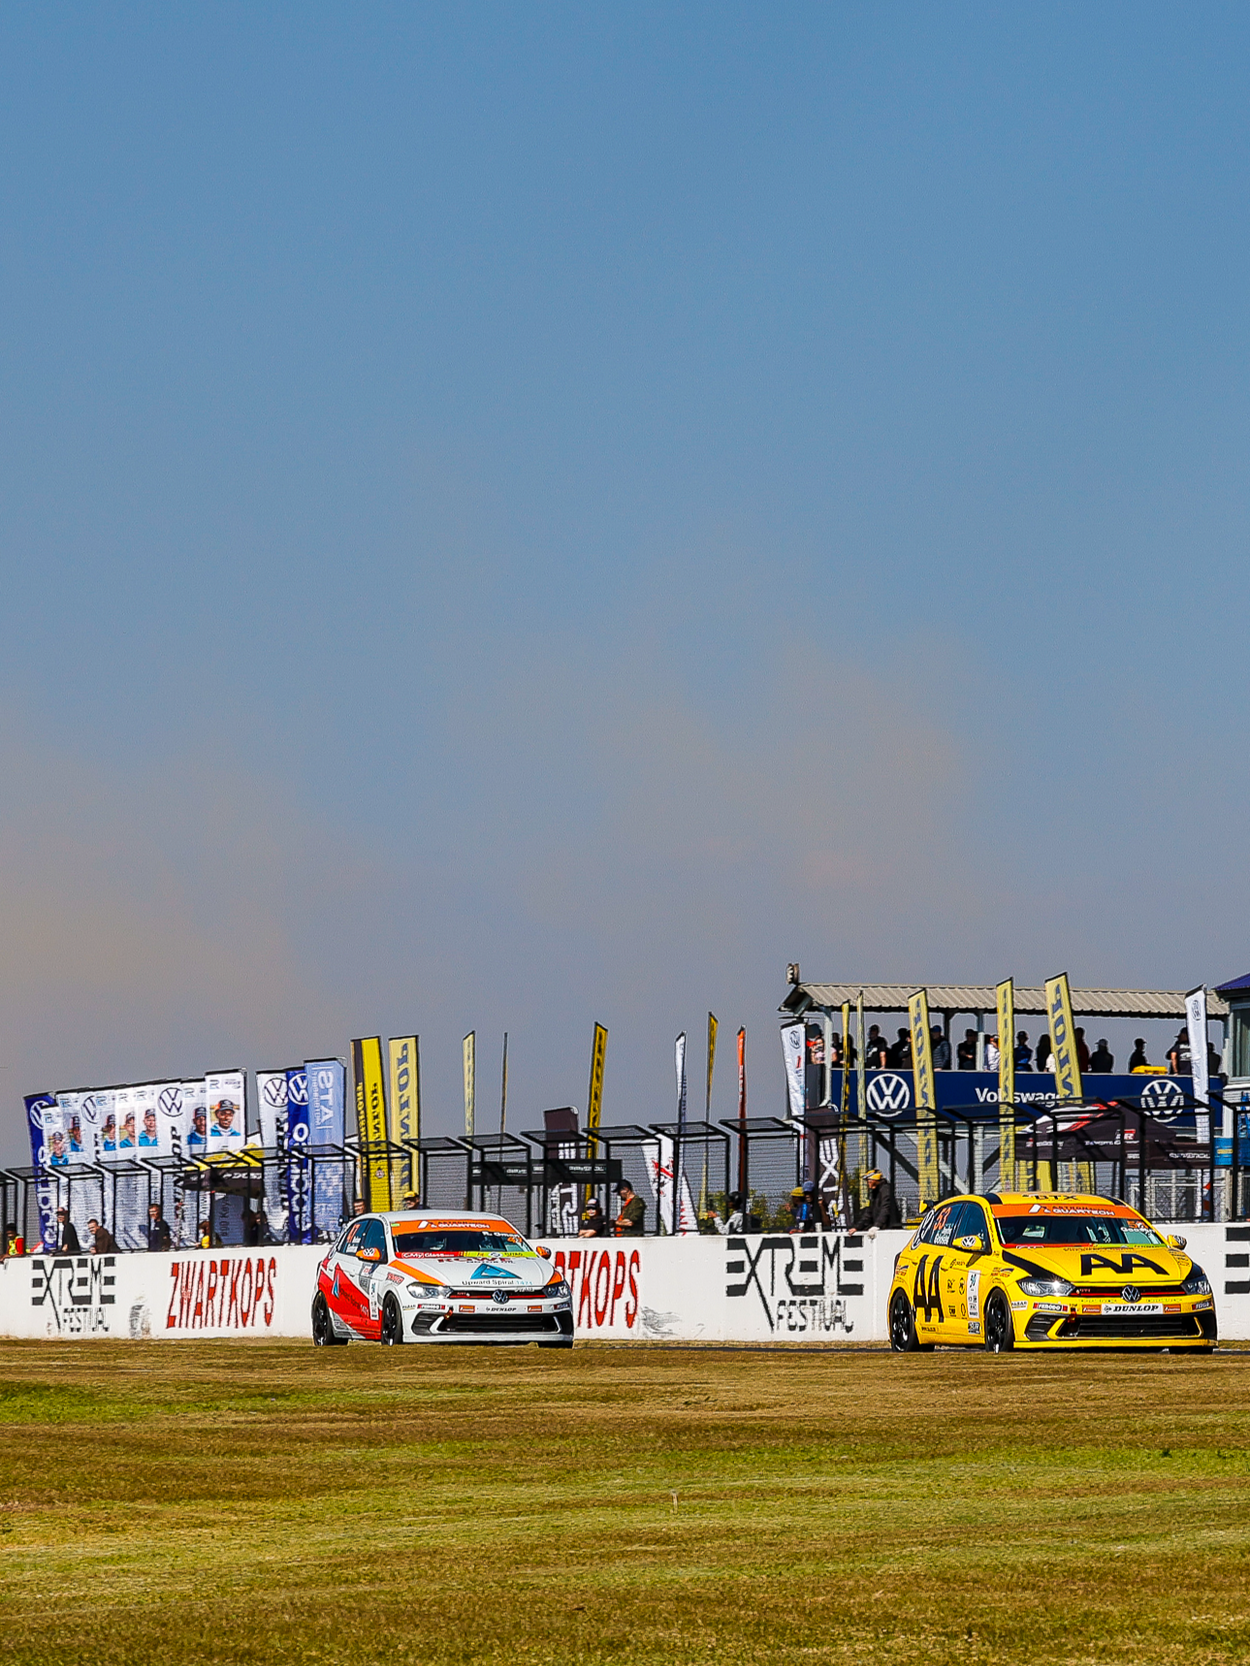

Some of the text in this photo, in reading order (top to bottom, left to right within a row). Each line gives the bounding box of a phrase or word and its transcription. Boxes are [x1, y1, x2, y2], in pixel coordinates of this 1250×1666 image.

[1052, 1208, 1115, 1216] QUARTECH
[32, 1257, 116, 1332] EXTREME
[166, 1256, 277, 1330] ZWARTKOPS
[726, 1236, 864, 1334] EXTREME
[913, 1254, 944, 1323] AA
[1080, 1254, 1170, 1276] AA
[1112, 1304, 1159, 1313] DUNLOP
